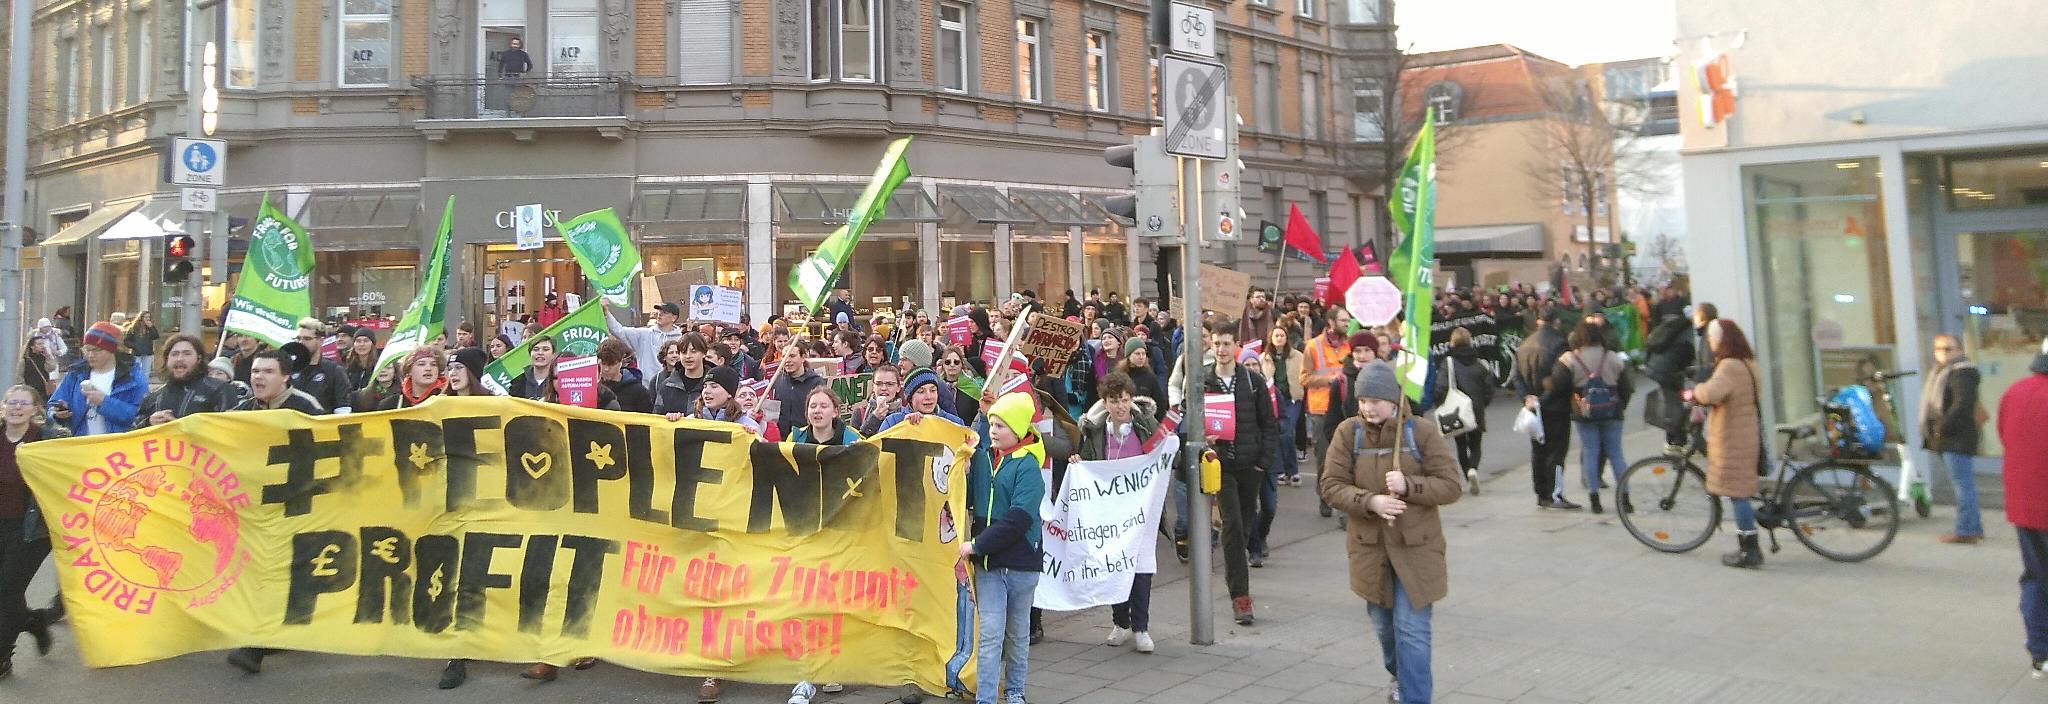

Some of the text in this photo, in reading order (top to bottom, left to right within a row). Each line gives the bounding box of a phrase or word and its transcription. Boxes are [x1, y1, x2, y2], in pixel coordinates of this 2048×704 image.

[561, 47, 581, 58] ACP
[1187, 37, 1200, 49] frei
[353, 50, 373, 62] ACP
[490, 51, 502, 62] AC
[1181, 132, 1212, 151] ZONE
[186, 174, 212, 183] ZONE
[495, 210, 562, 229] CHST
[362, 291, 386, 300] 60%
[1035, 317, 1080, 336] DESTROY
[1032, 347, 1070, 360] NOT THE
[746, 438, 945, 543] NOT
[60, 438, 250, 615] FRIDAYS FOR FUTURE
[621, 540, 675, 595] Für
[683, 551, 750, 598] eine
[283, 526, 621, 640] PROFIT
[612, 604, 689, 655] ohne
